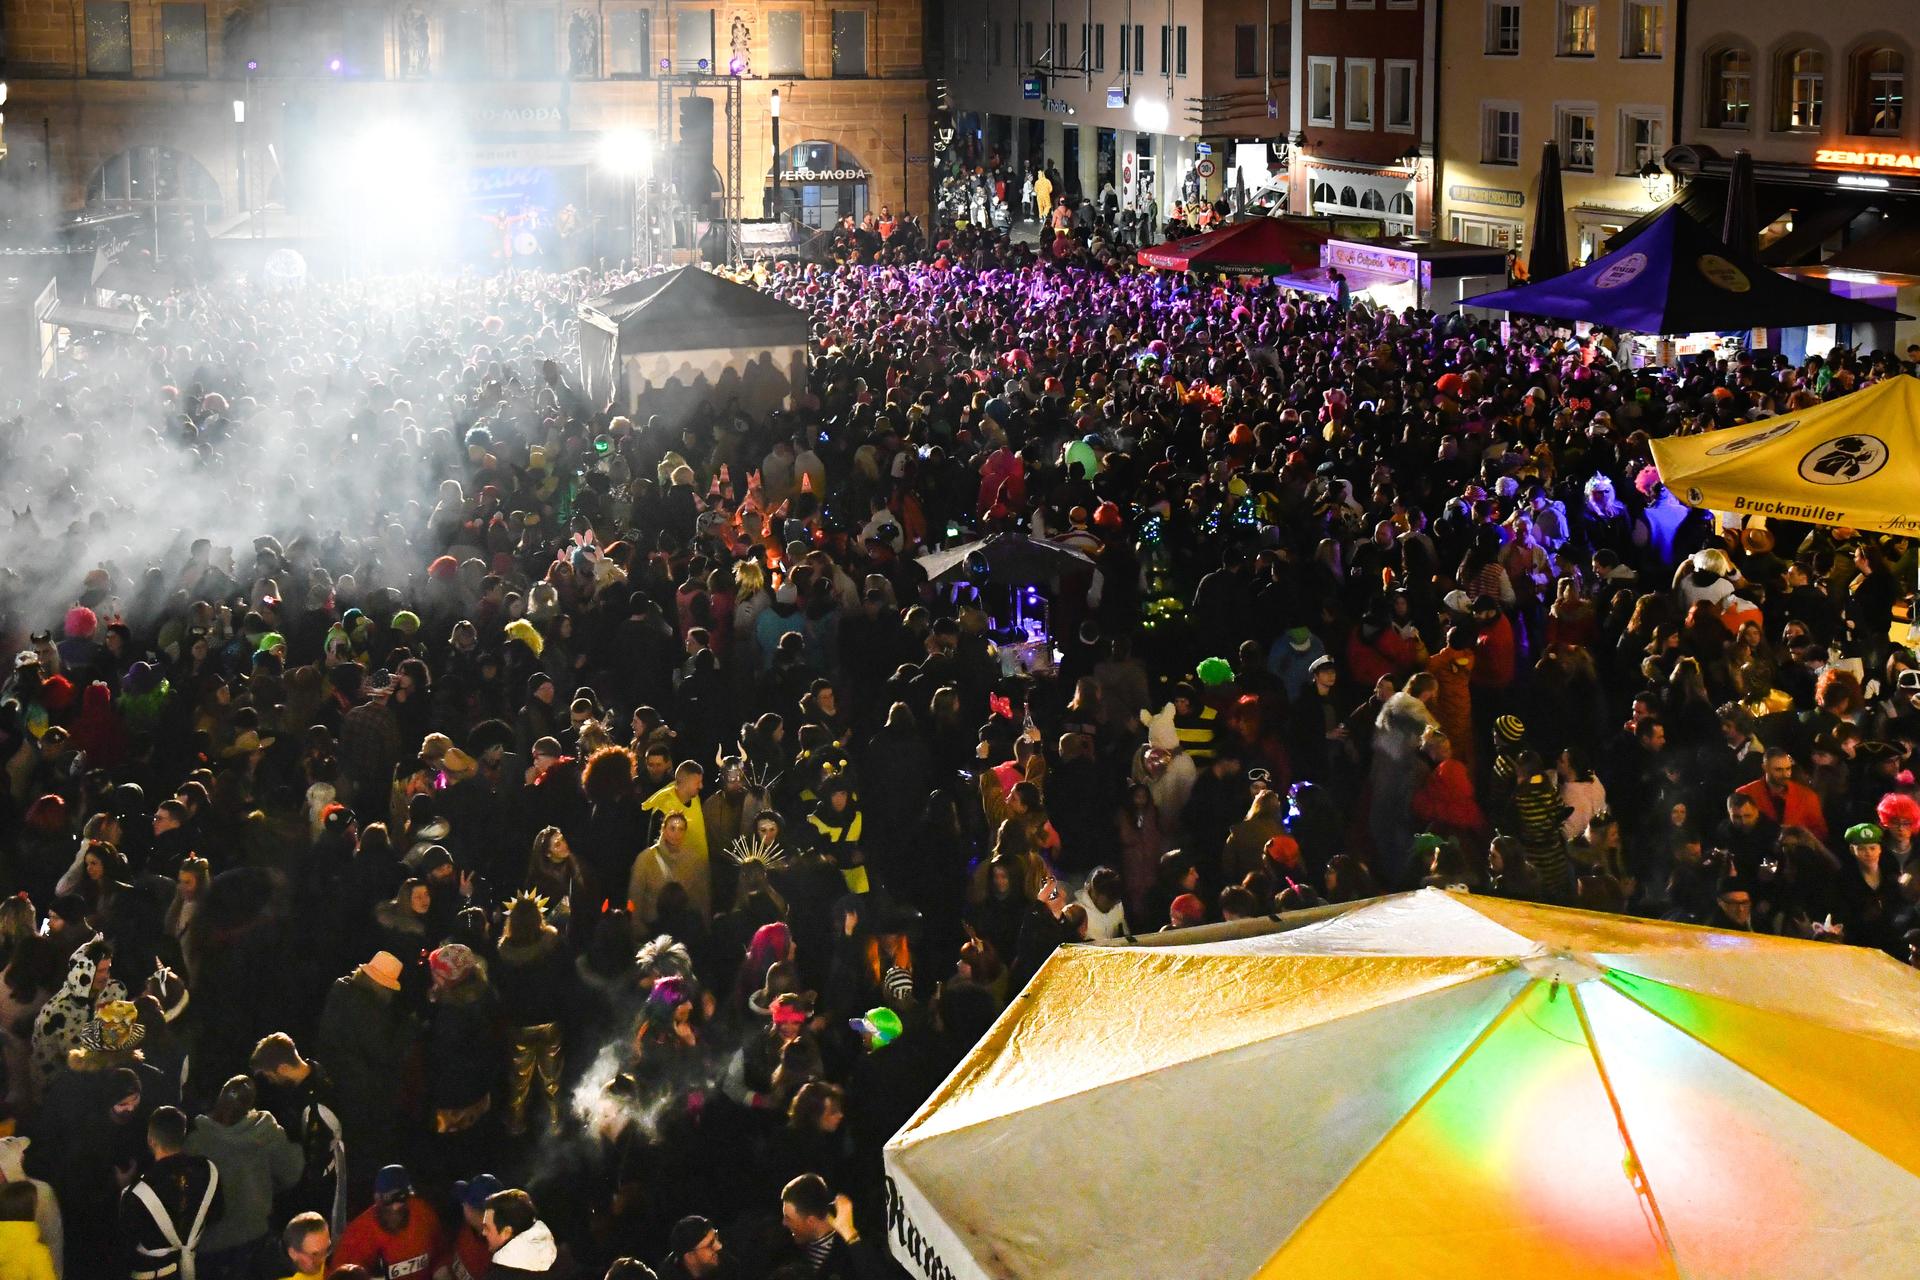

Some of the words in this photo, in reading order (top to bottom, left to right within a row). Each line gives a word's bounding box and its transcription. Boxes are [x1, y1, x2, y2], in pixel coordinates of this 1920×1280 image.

[1047, 99, 1067, 113] Thalia
[503, 107, 561, 121] MODA
[820, 169, 865, 180] MODA
[1735, 496, 1845, 522] Bruckmüller
